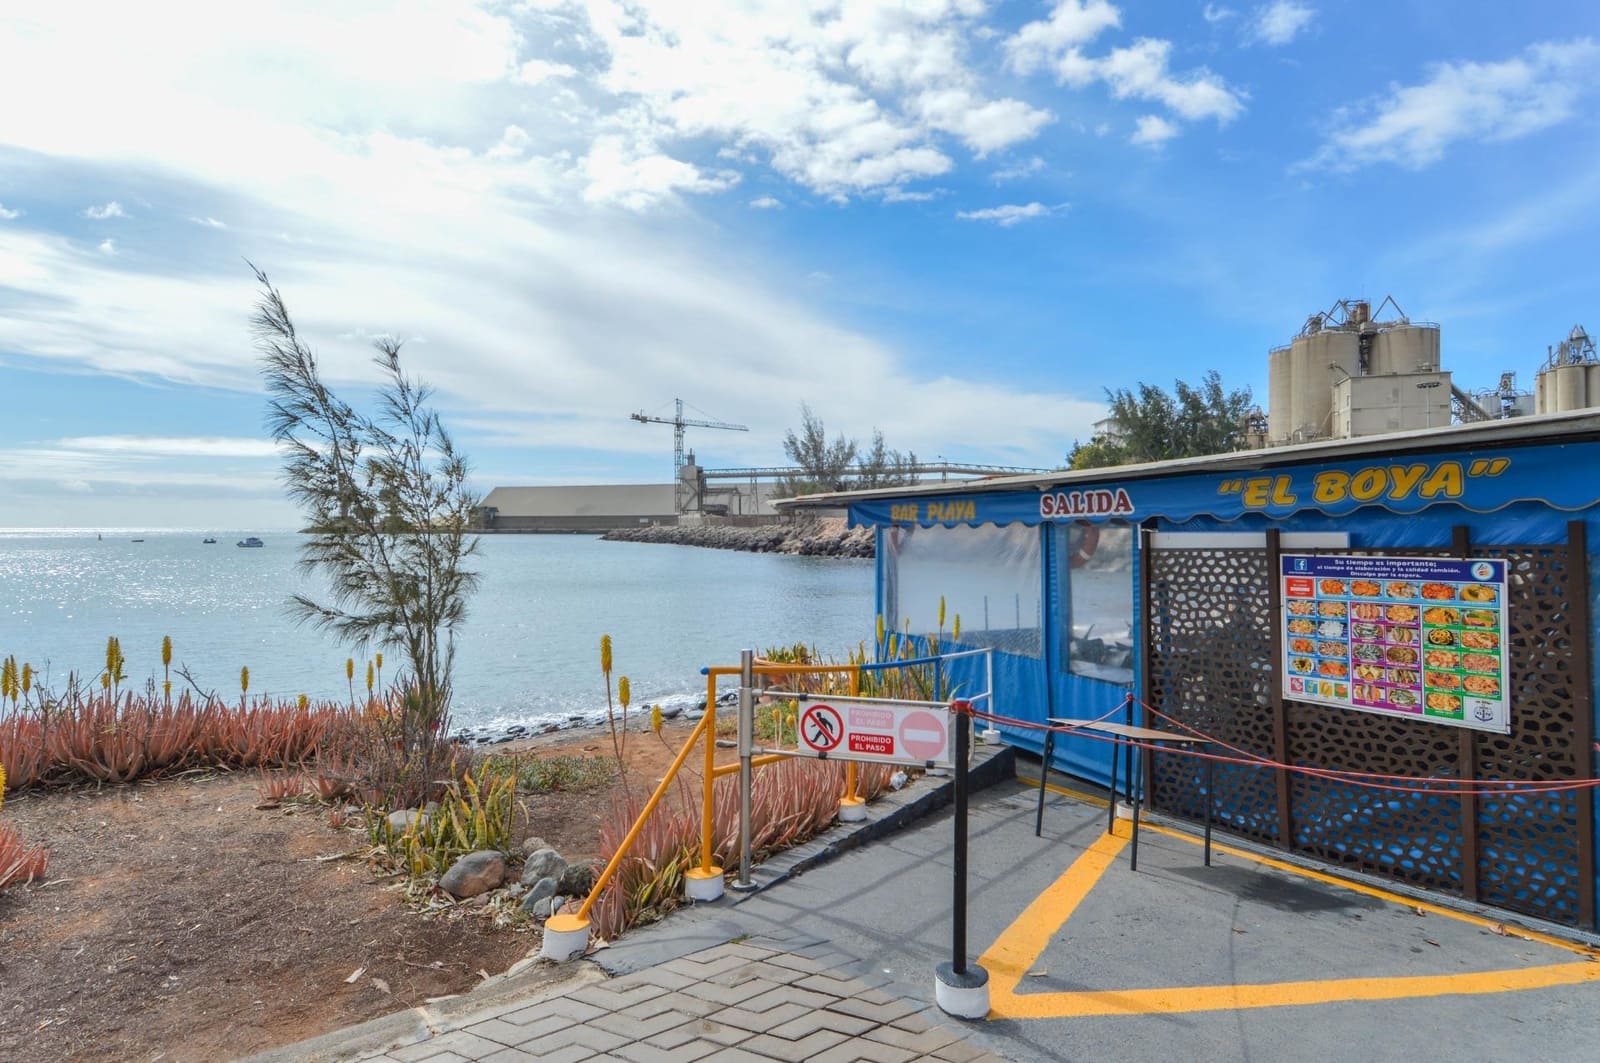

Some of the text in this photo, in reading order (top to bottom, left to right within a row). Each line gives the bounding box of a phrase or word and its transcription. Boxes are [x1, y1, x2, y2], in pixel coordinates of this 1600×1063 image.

[1040, 489, 1134, 517] SALIDA
[890, 501, 977, 522] BAR PLAYA
[1346, 559, 1374, 567] tiempo
[850, 709, 892, 720] PROHIBIDO
[850, 734, 892, 744] PROHIBIDO
[854, 742, 886, 752] EL PASO
